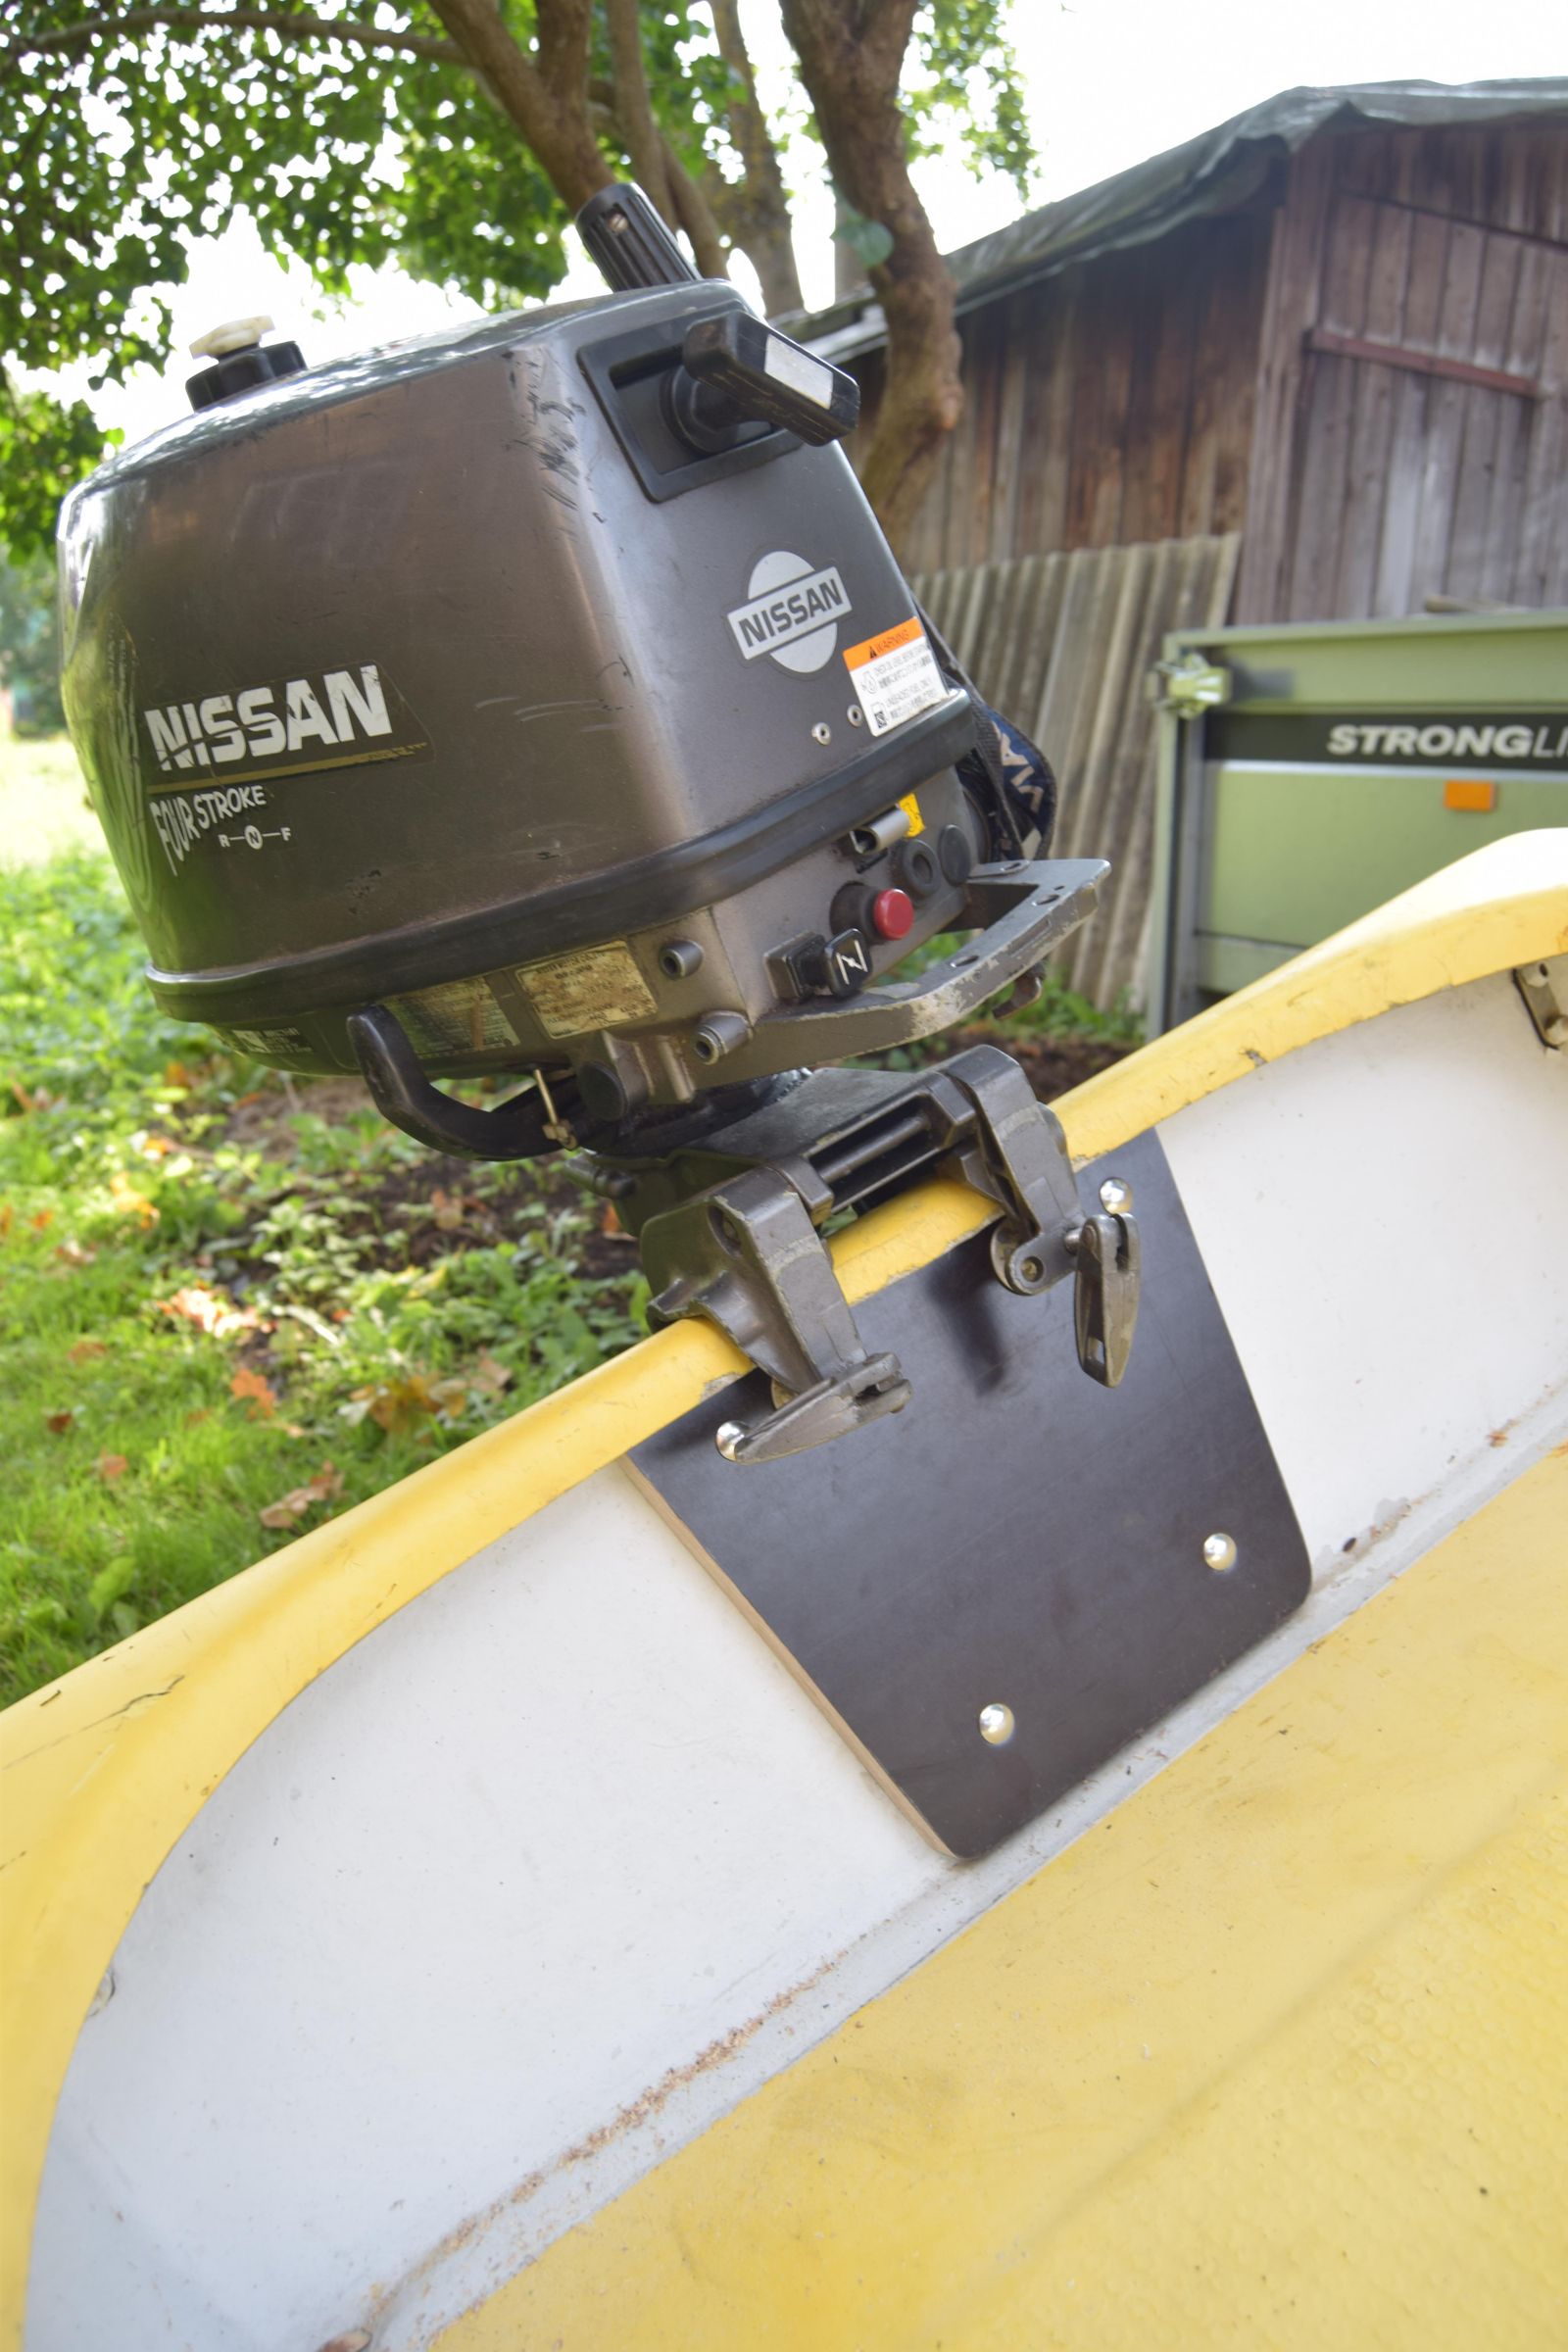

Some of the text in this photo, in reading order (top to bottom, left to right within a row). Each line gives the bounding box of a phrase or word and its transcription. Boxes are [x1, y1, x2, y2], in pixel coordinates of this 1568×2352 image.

[738, 578, 843, 647] NISSAN
[144, 664, 393, 771] NISSAN
[1327, 723, 1568, 759] STRONGLI
[149, 785, 267, 877] FOUR STROKE
